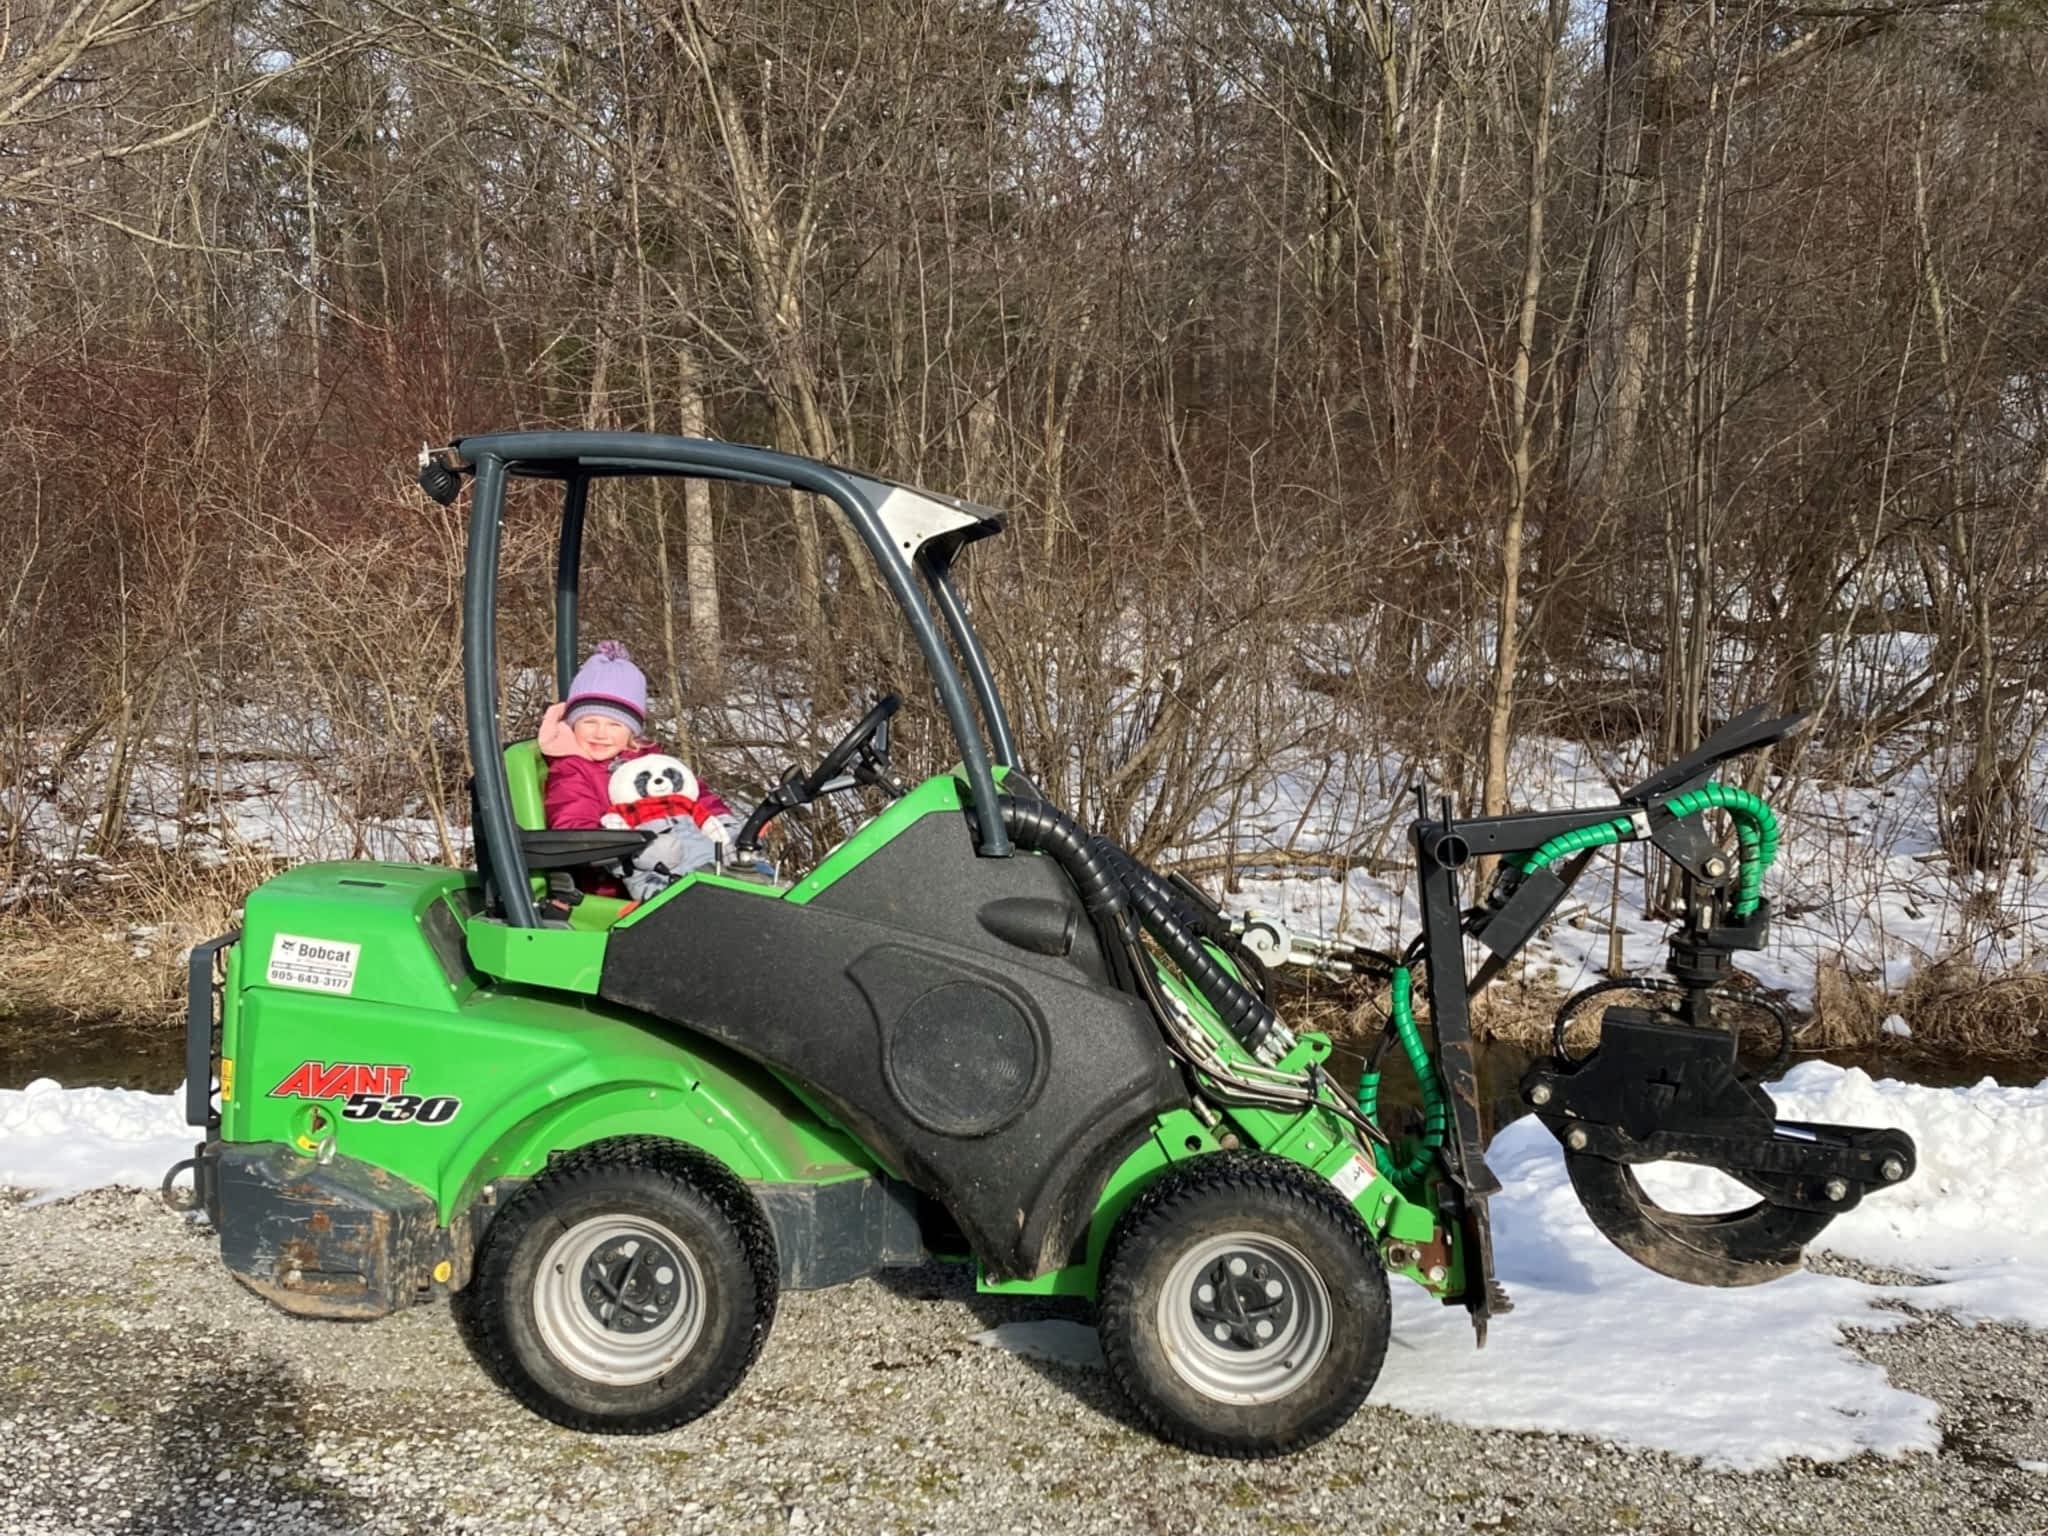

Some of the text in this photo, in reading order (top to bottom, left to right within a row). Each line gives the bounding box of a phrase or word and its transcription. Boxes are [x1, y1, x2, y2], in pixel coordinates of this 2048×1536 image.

[298, 943, 351, 962] Bobcat
[271, 969, 349, 988] 905-643-3177
[267, 1061, 411, 1100] AVANT
[341, 1093, 462, 1125] 530
